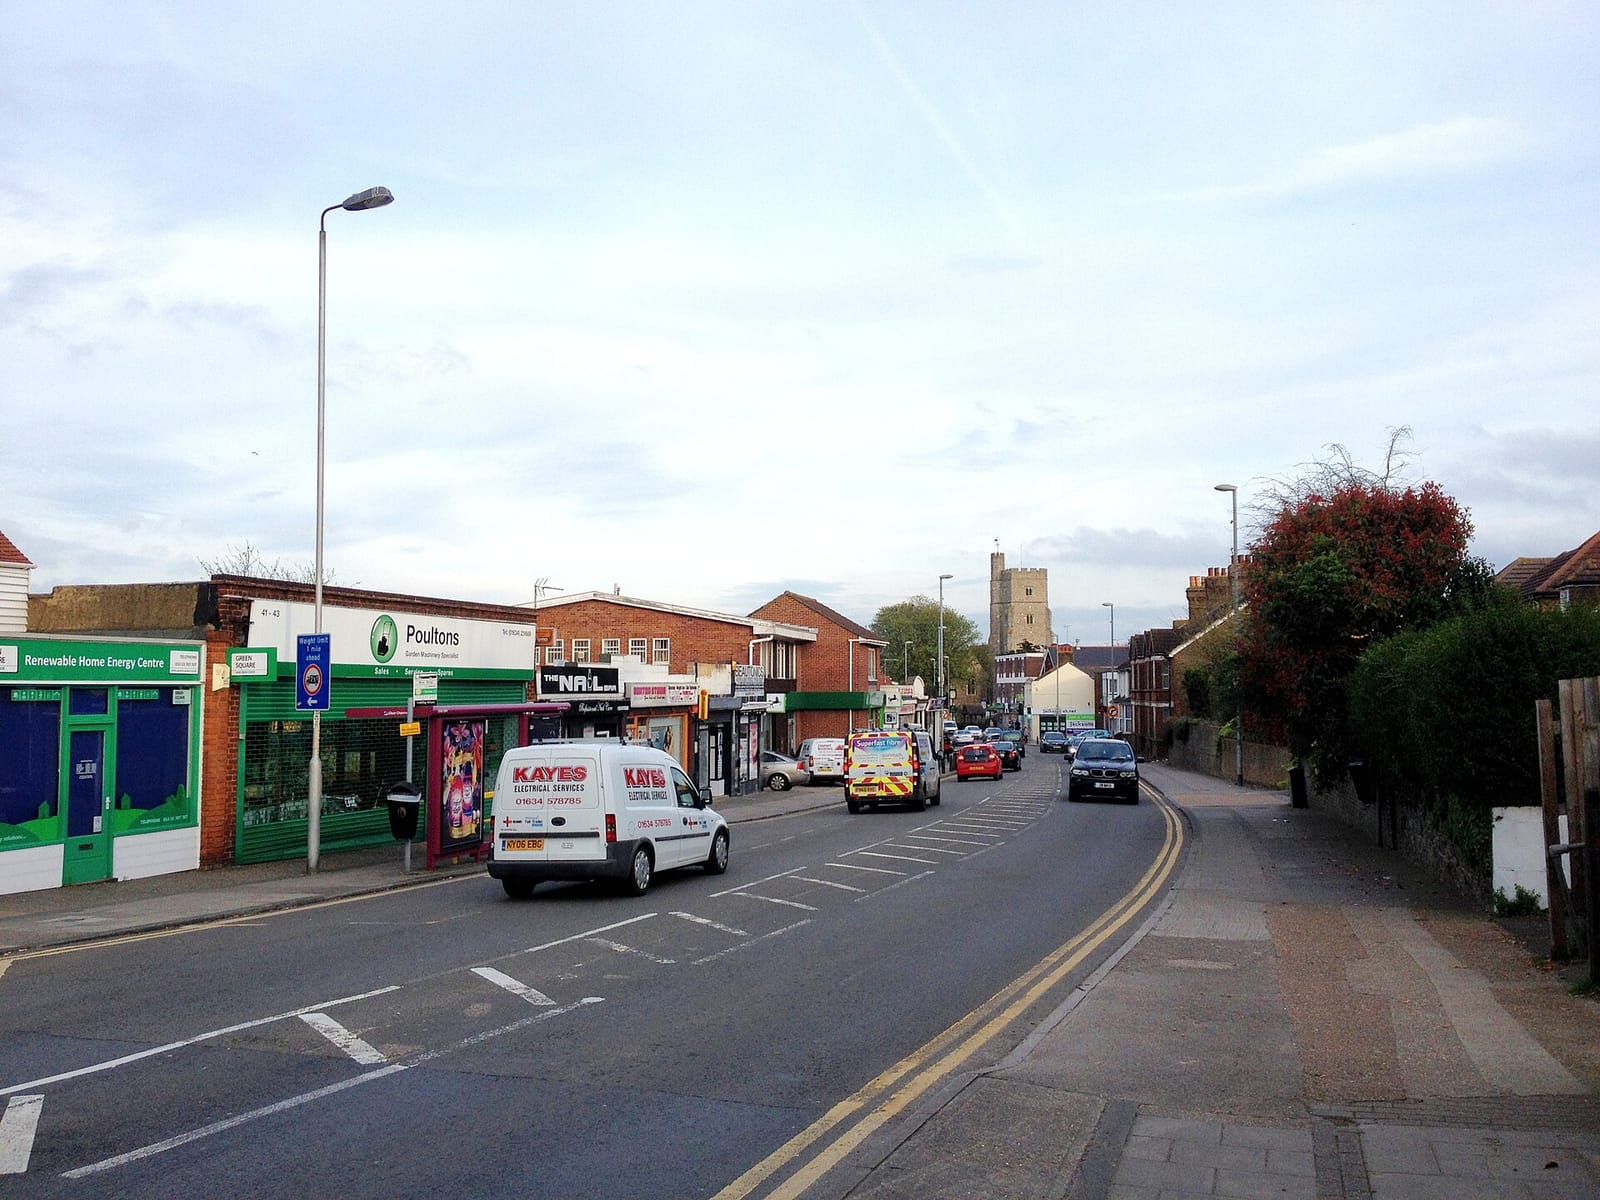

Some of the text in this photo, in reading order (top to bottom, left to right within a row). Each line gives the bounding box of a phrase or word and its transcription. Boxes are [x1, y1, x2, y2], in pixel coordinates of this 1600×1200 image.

[272, 610, 280, 618] 43
[299, 636, 316, 646] Weight
[406, 625, 459, 646] Poultons
[25, 655, 164, 669] Renewable Home Energy Centre
[513, 766, 587, 783] KAYES
[623, 768, 666, 788] KAYES
[629, 791, 667, 800] ELECTRICAL SERVICES
